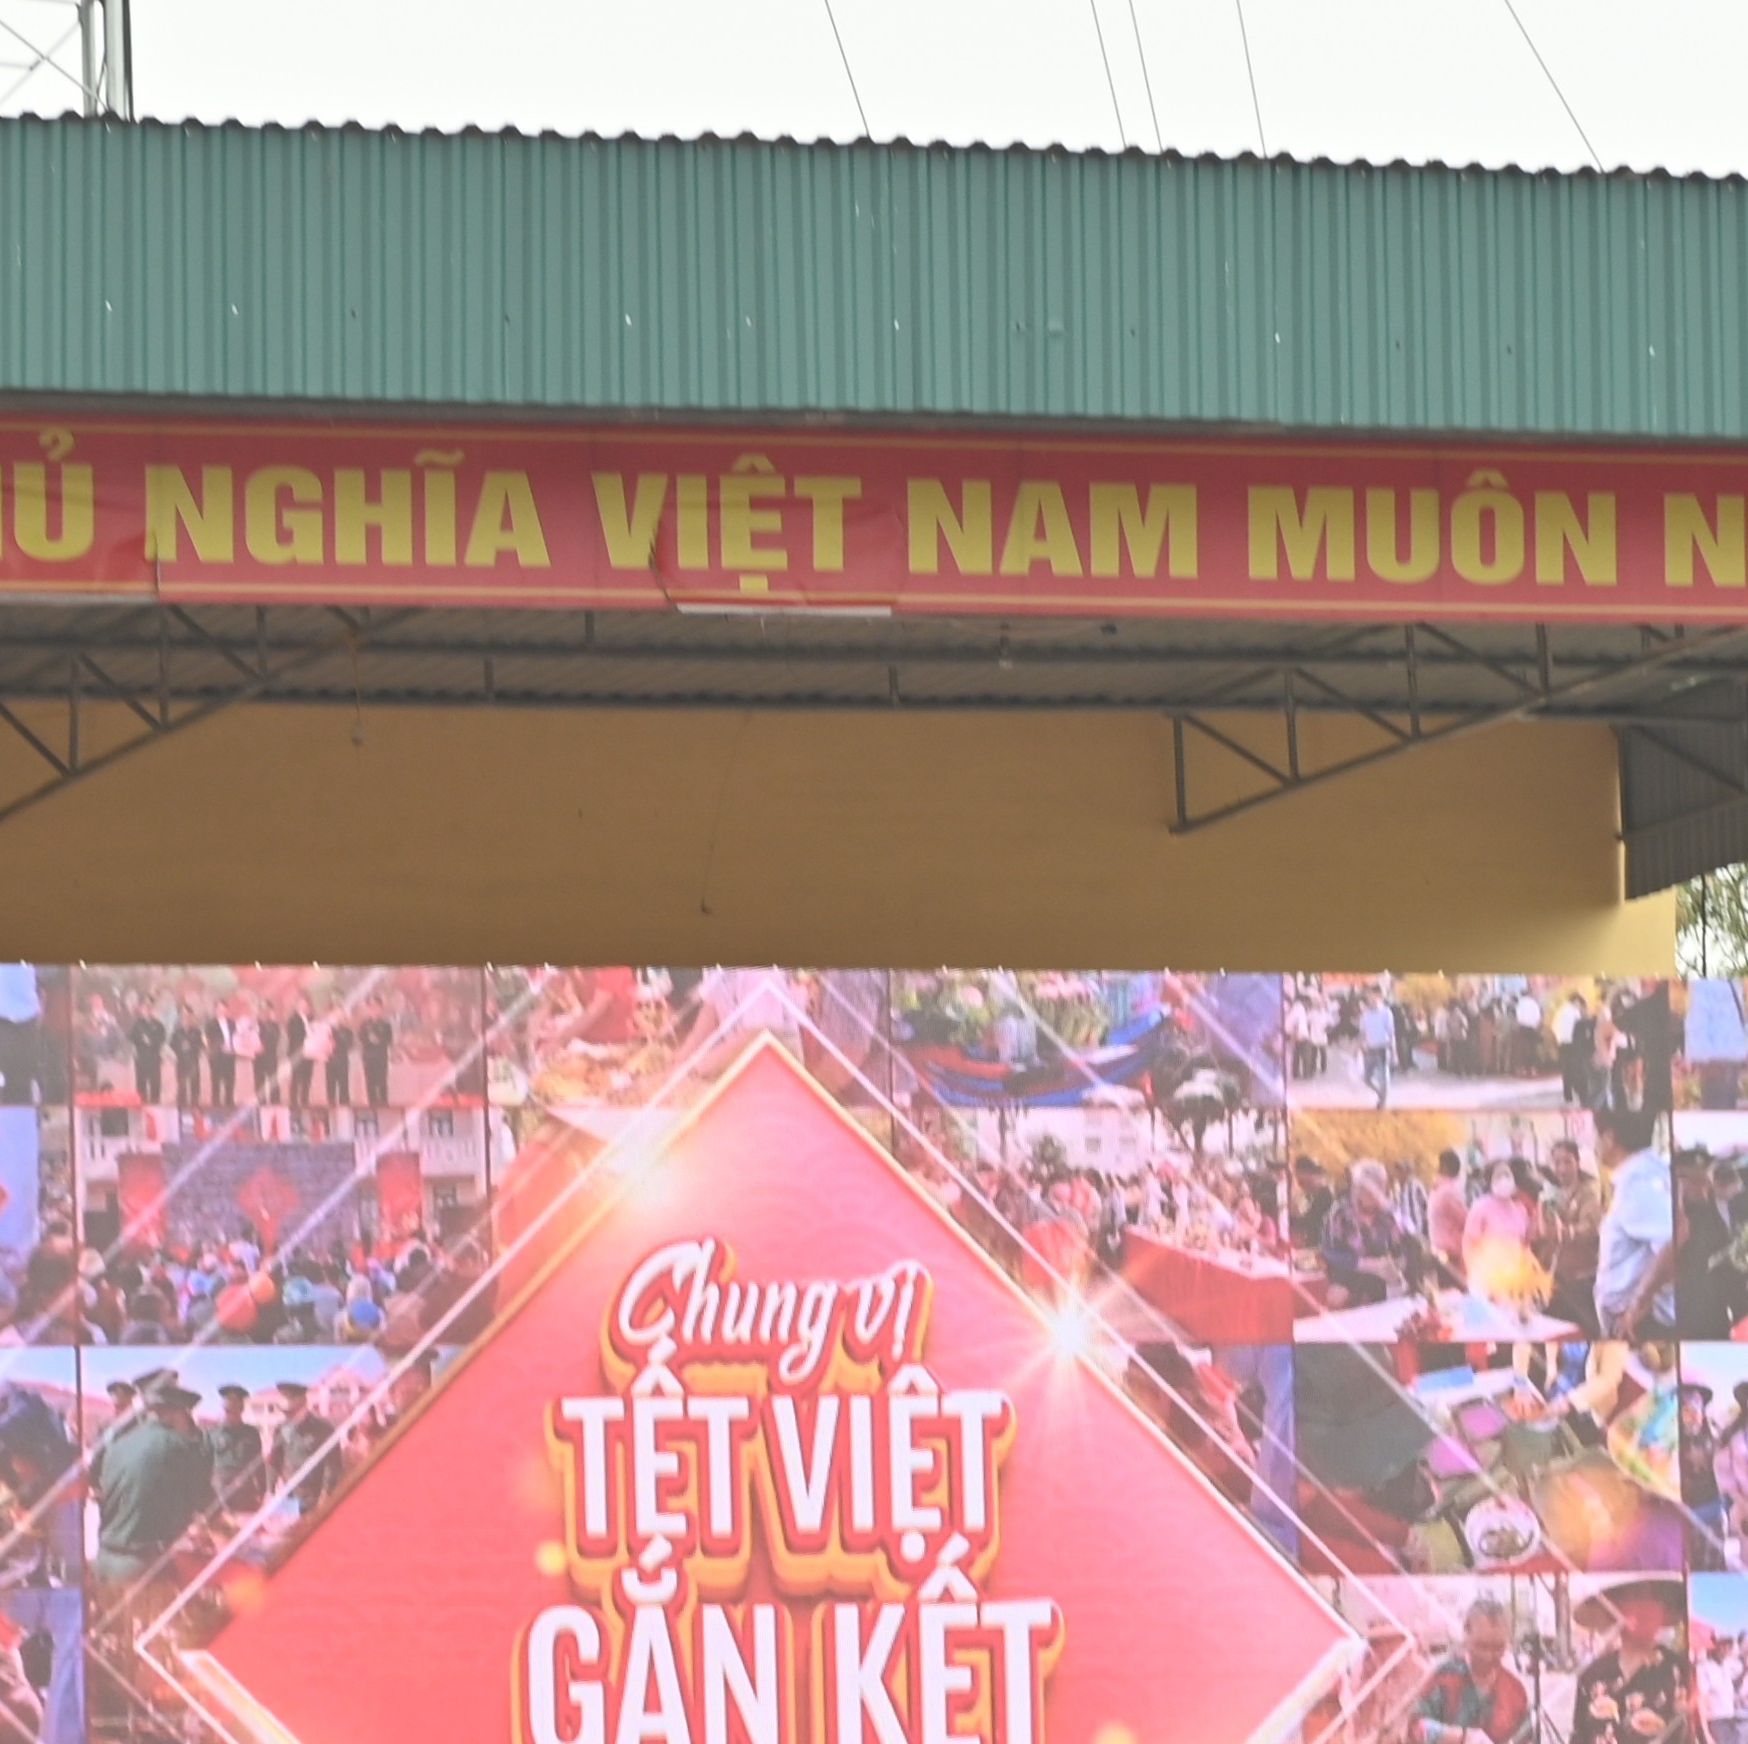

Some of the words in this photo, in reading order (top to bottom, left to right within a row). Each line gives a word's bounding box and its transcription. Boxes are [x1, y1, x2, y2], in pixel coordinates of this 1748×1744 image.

[143, 448, 552, 568] NGHĨA
[591, 452, 862, 592] VIỆT
[906, 477, 1199, 579] NAM
[1246, 467, 1617, 587] MUÔN
[617, 1238, 838, 1384] Chung
[855, 1259, 929, 1360] vị
[561, 1337, 750, 1538] TẾT
[769, 1363, 1008, 1562] VIỆT
